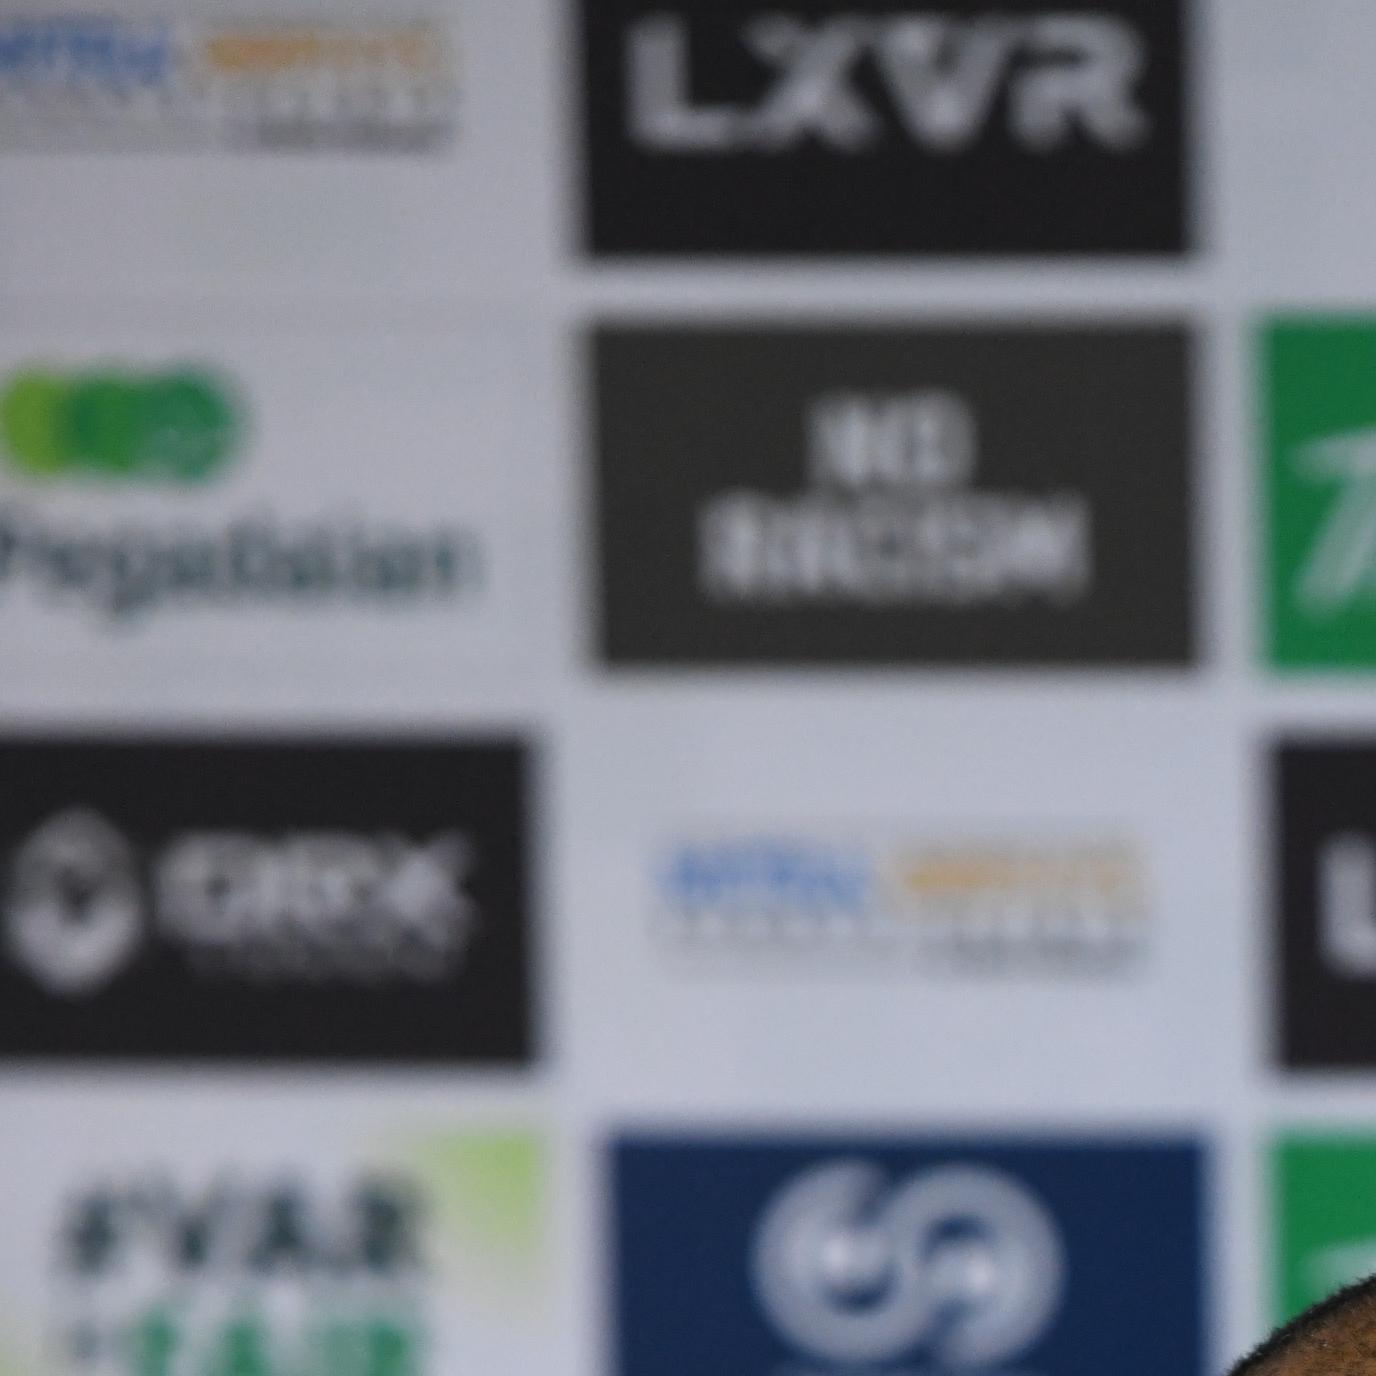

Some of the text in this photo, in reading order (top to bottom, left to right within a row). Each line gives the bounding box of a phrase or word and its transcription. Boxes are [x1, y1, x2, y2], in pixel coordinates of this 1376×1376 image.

[628, 13, 1146, 150] LXVR
[812, 394, 974, 482] NO
[700, 495, 1090, 602] RACISM
